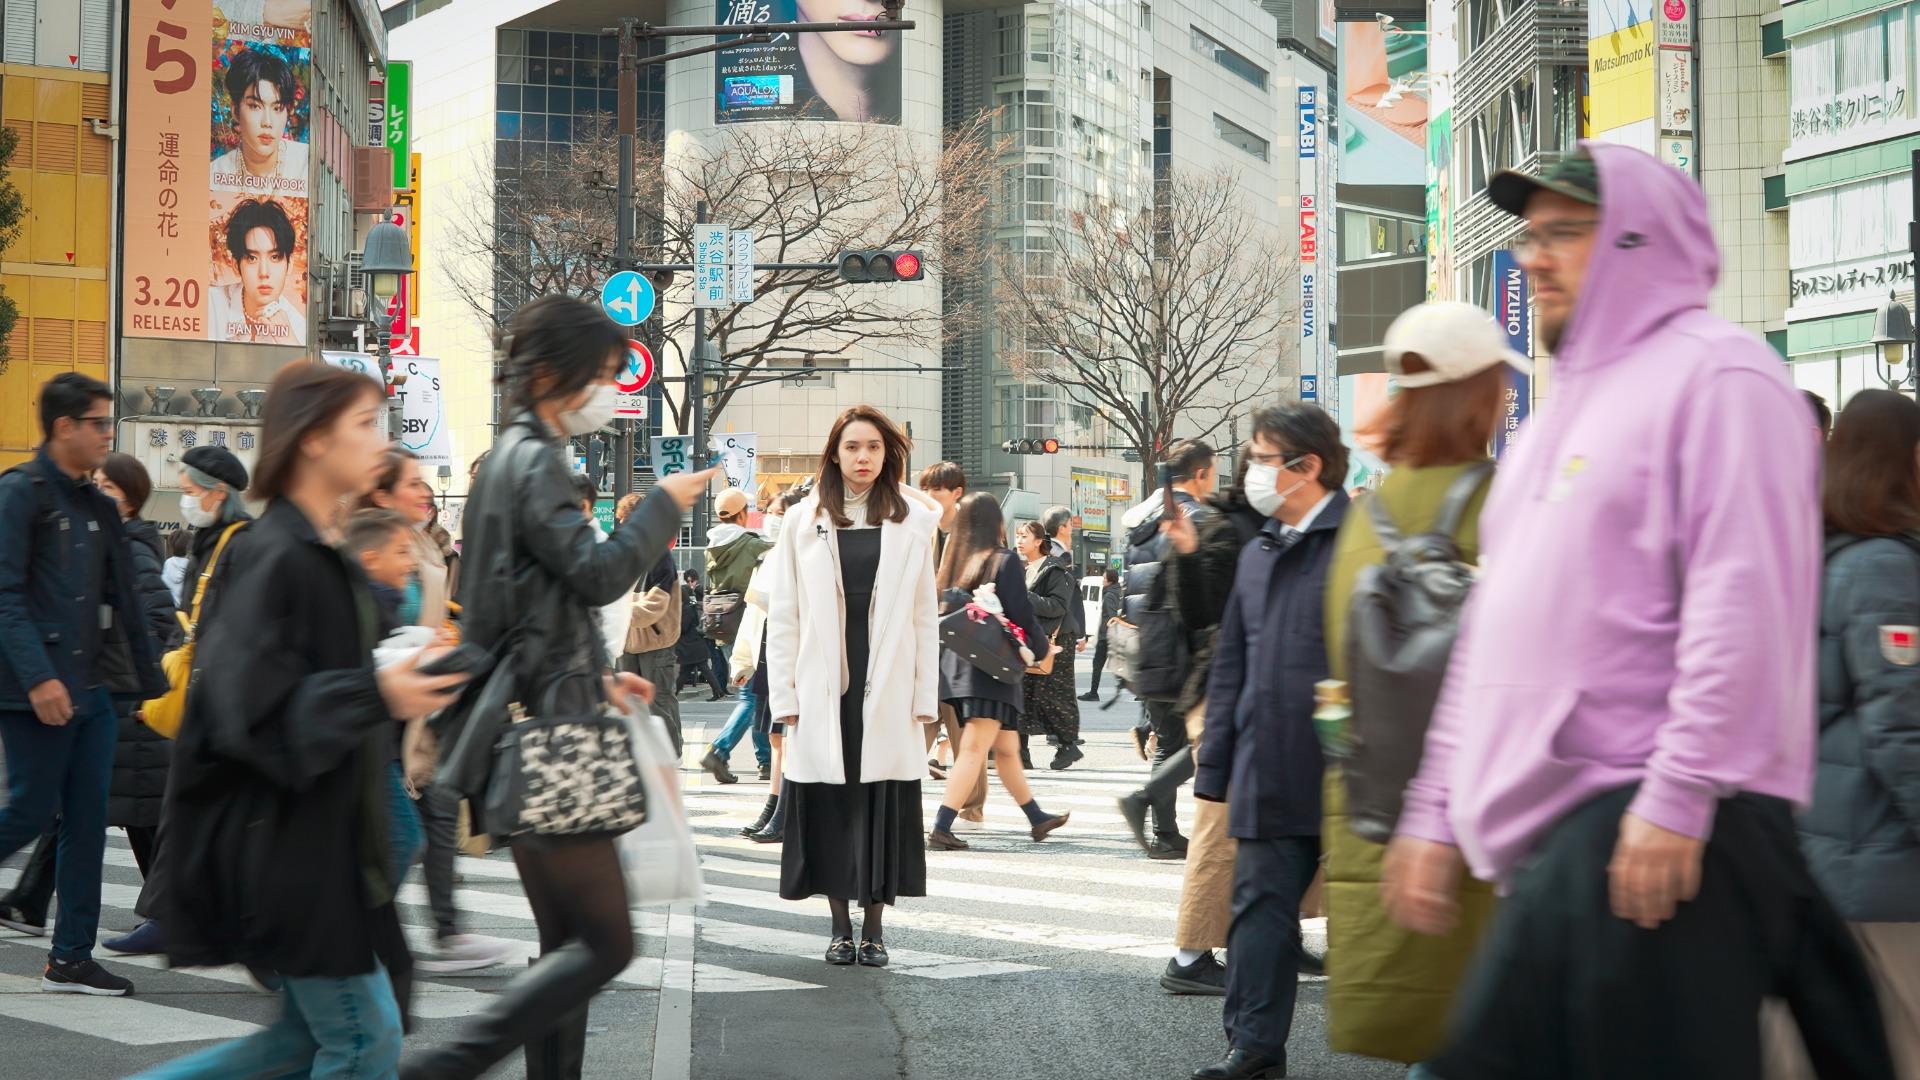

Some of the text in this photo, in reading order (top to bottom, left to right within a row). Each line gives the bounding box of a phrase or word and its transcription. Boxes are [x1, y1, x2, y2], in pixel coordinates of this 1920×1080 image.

[146, 0, 196, 95] ら
[230, 22, 295, 39] KIM GYU VIN
[1594, 48, 1643, 73] Matsumoto
[731, 86, 777, 96] AQUALOX
[389, 104, 404, 144] レイク
[1300, 109, 1316, 154] LABI
[214, 173, 306, 190] PARK GUN WOOK
[1300, 210, 1316, 263] LABI
[698, 241, 707, 290] Shibuya Sta
[709, 231, 724, 301] 渋谷駅前
[134, 275, 200, 308] 3.20
[1303, 274, 1314, 338] SHIBUYA
[1507, 268, 1521, 336] MIZUHO
[133, 314, 201, 332] RELEASE
[228, 324, 289, 337] HAN YU JIN
[150, 428, 255, 449] 渋谷駅前
